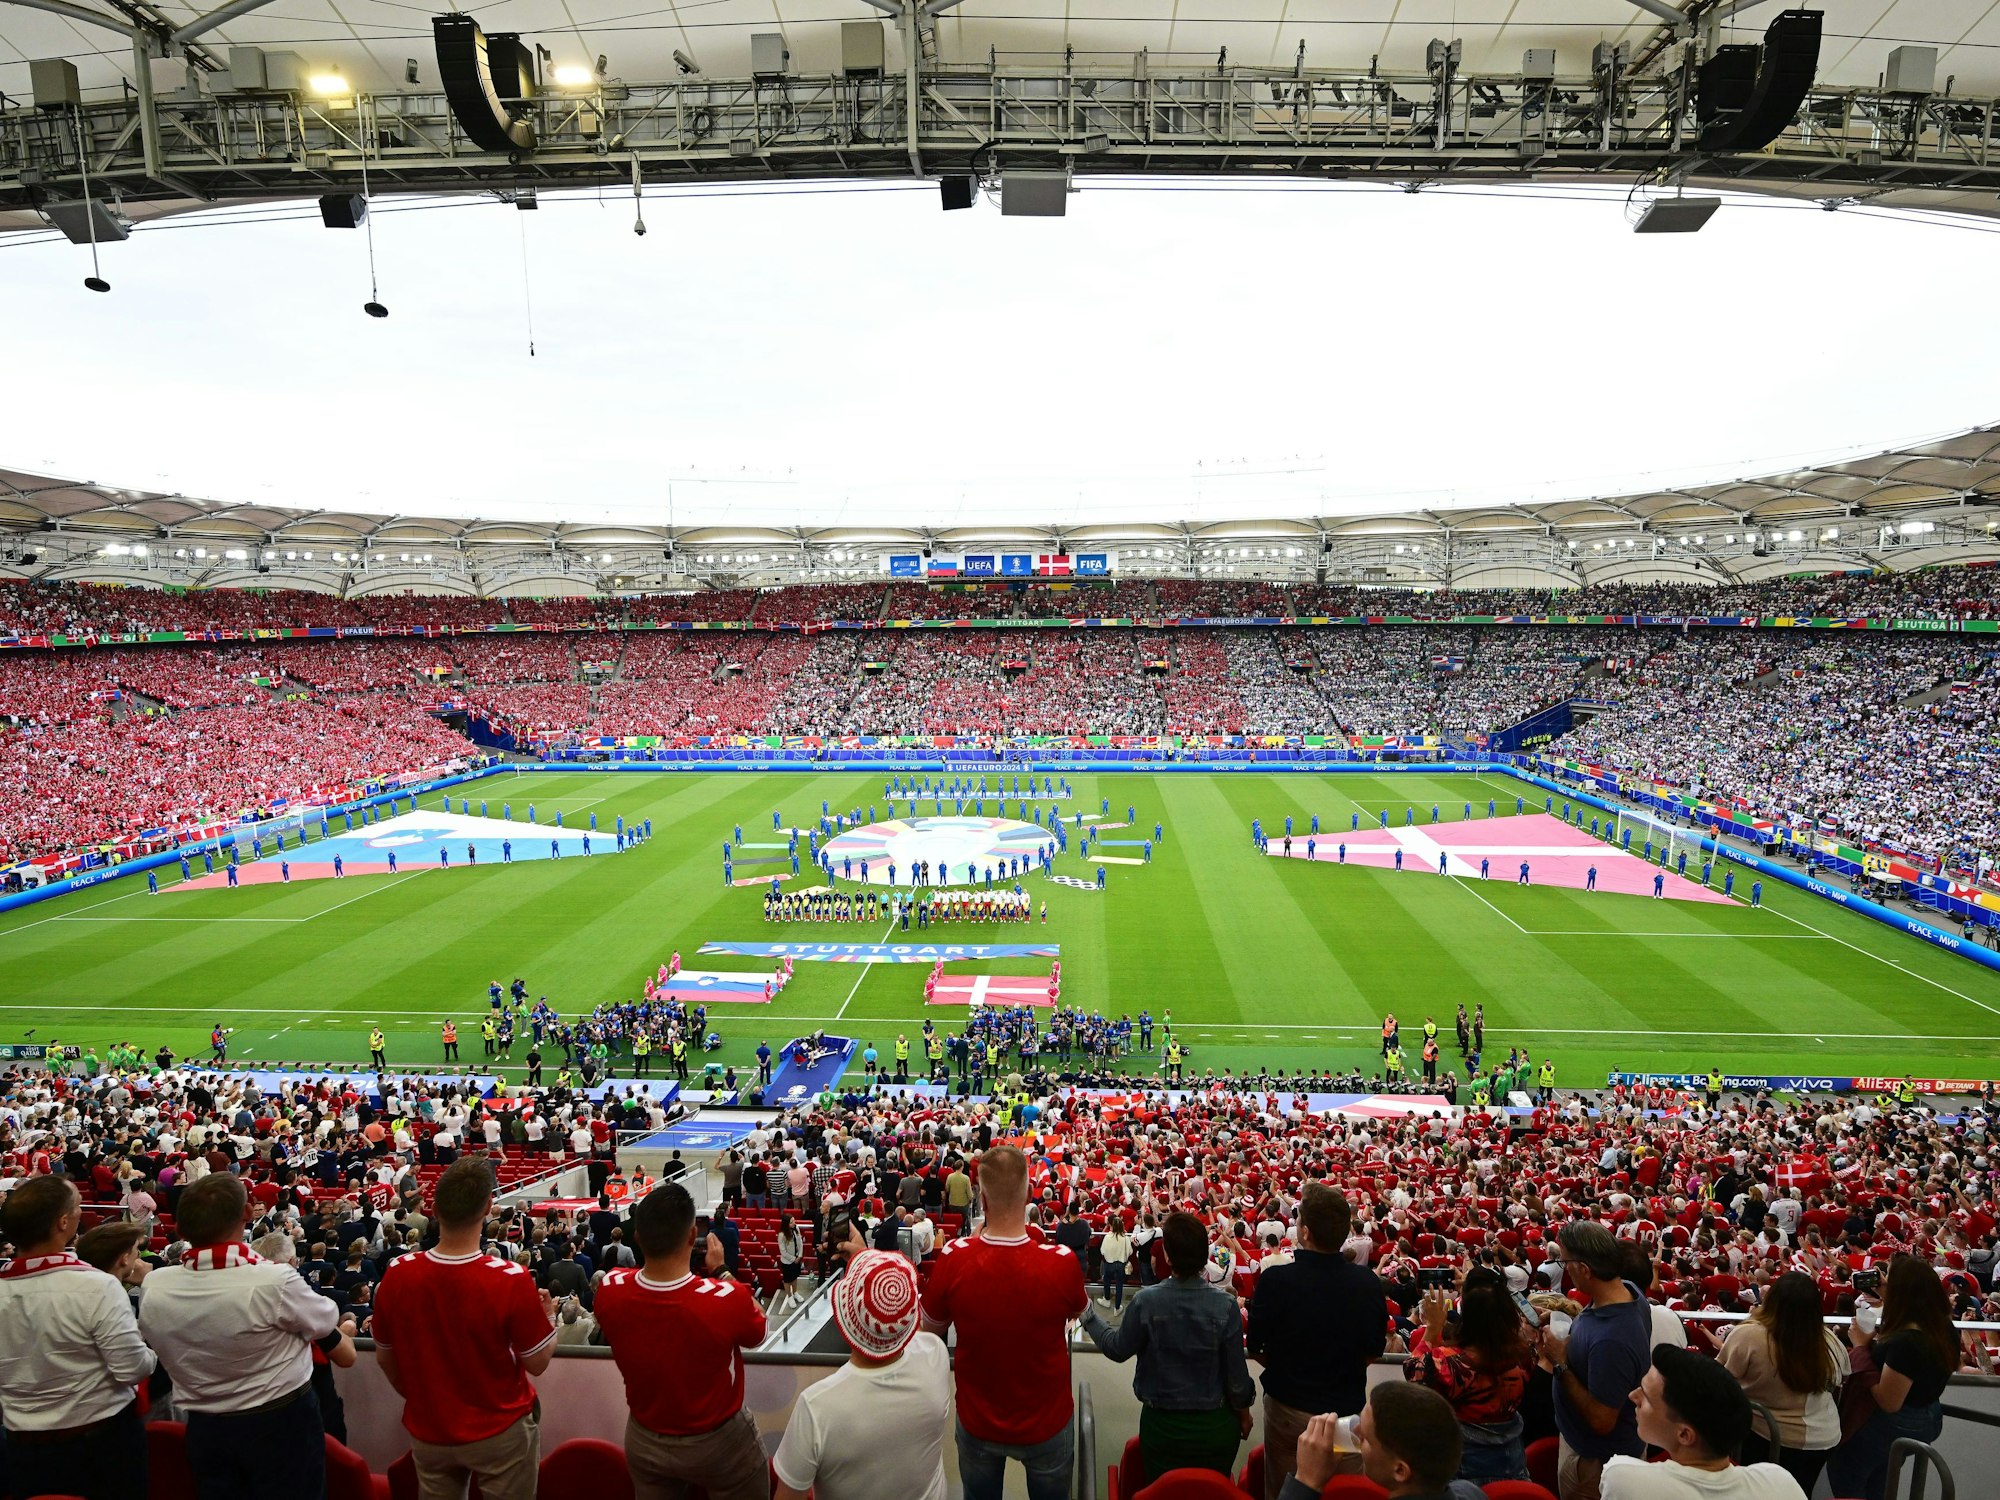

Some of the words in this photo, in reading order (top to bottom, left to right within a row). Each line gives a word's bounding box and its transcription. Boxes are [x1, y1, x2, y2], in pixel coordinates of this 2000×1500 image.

[967, 561, 992, 570] UEFA
[1080, 560, 1103, 569] FIFA
[1897, 620, 1959, 630] STUTTGAT
[180, 847, 200, 858] PEACE
[1725, 849, 1741, 861] PEACE
[71, 877, 95, 889] PEACE
[102, 869, 120, 880] МИР
[1807, 880, 1827, 895] PEACE
[1832, 890, 1848, 903] МИР
[1908, 921, 1933, 939] PEACE
[1939, 935, 1960, 949] МИР
[768, 943, 990, 957] STUTTGART
[1789, 1077, 1833, 1089] vivo
[1946, 1082, 1975, 1090] BETANO
[372, 1192, 387, 1210] 23
[1788, 1210, 1795, 1222] 9
[1640, 1230, 1656, 1243] 10
